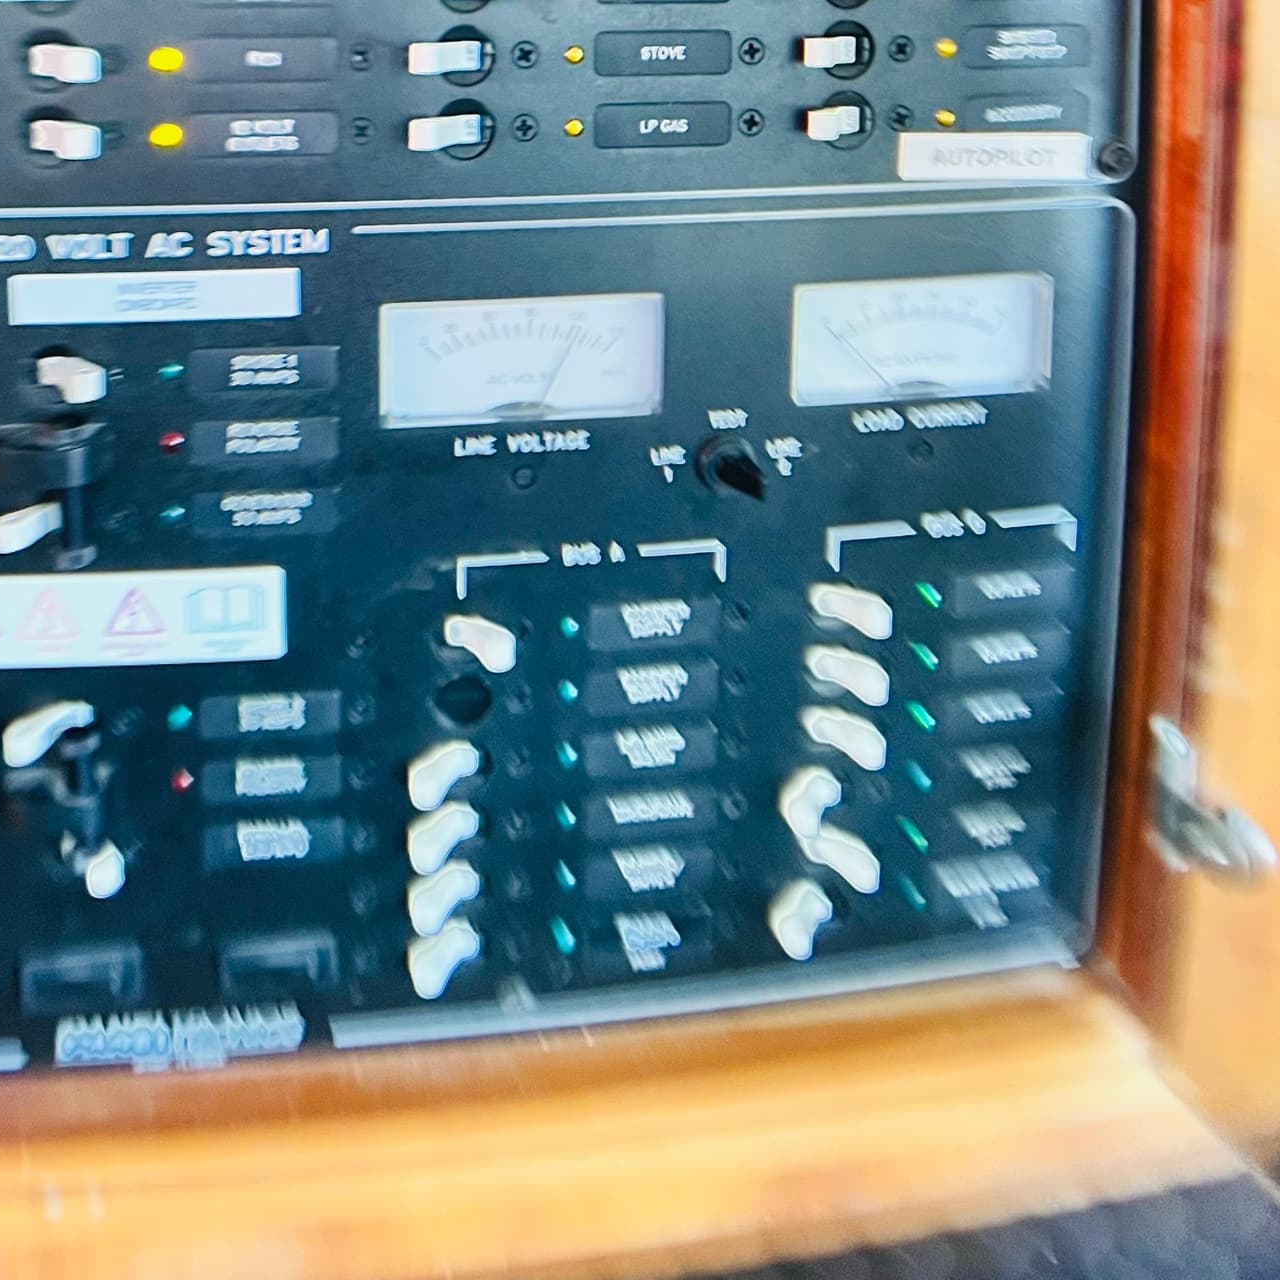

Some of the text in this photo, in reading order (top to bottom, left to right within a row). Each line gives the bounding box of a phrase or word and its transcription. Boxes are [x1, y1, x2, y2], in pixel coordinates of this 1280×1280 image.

[640, 45, 687, 61] STOVE
[640, 118, 688, 134] LP GAS
[931, 147, 1057, 169] AUTOPILOT
[45, 232, 136, 260] VOLT
[144, 231, 194, 259] AC
[206, 228, 330, 258] SYSTEM
[507, 428, 591, 453] VOLTAGE
